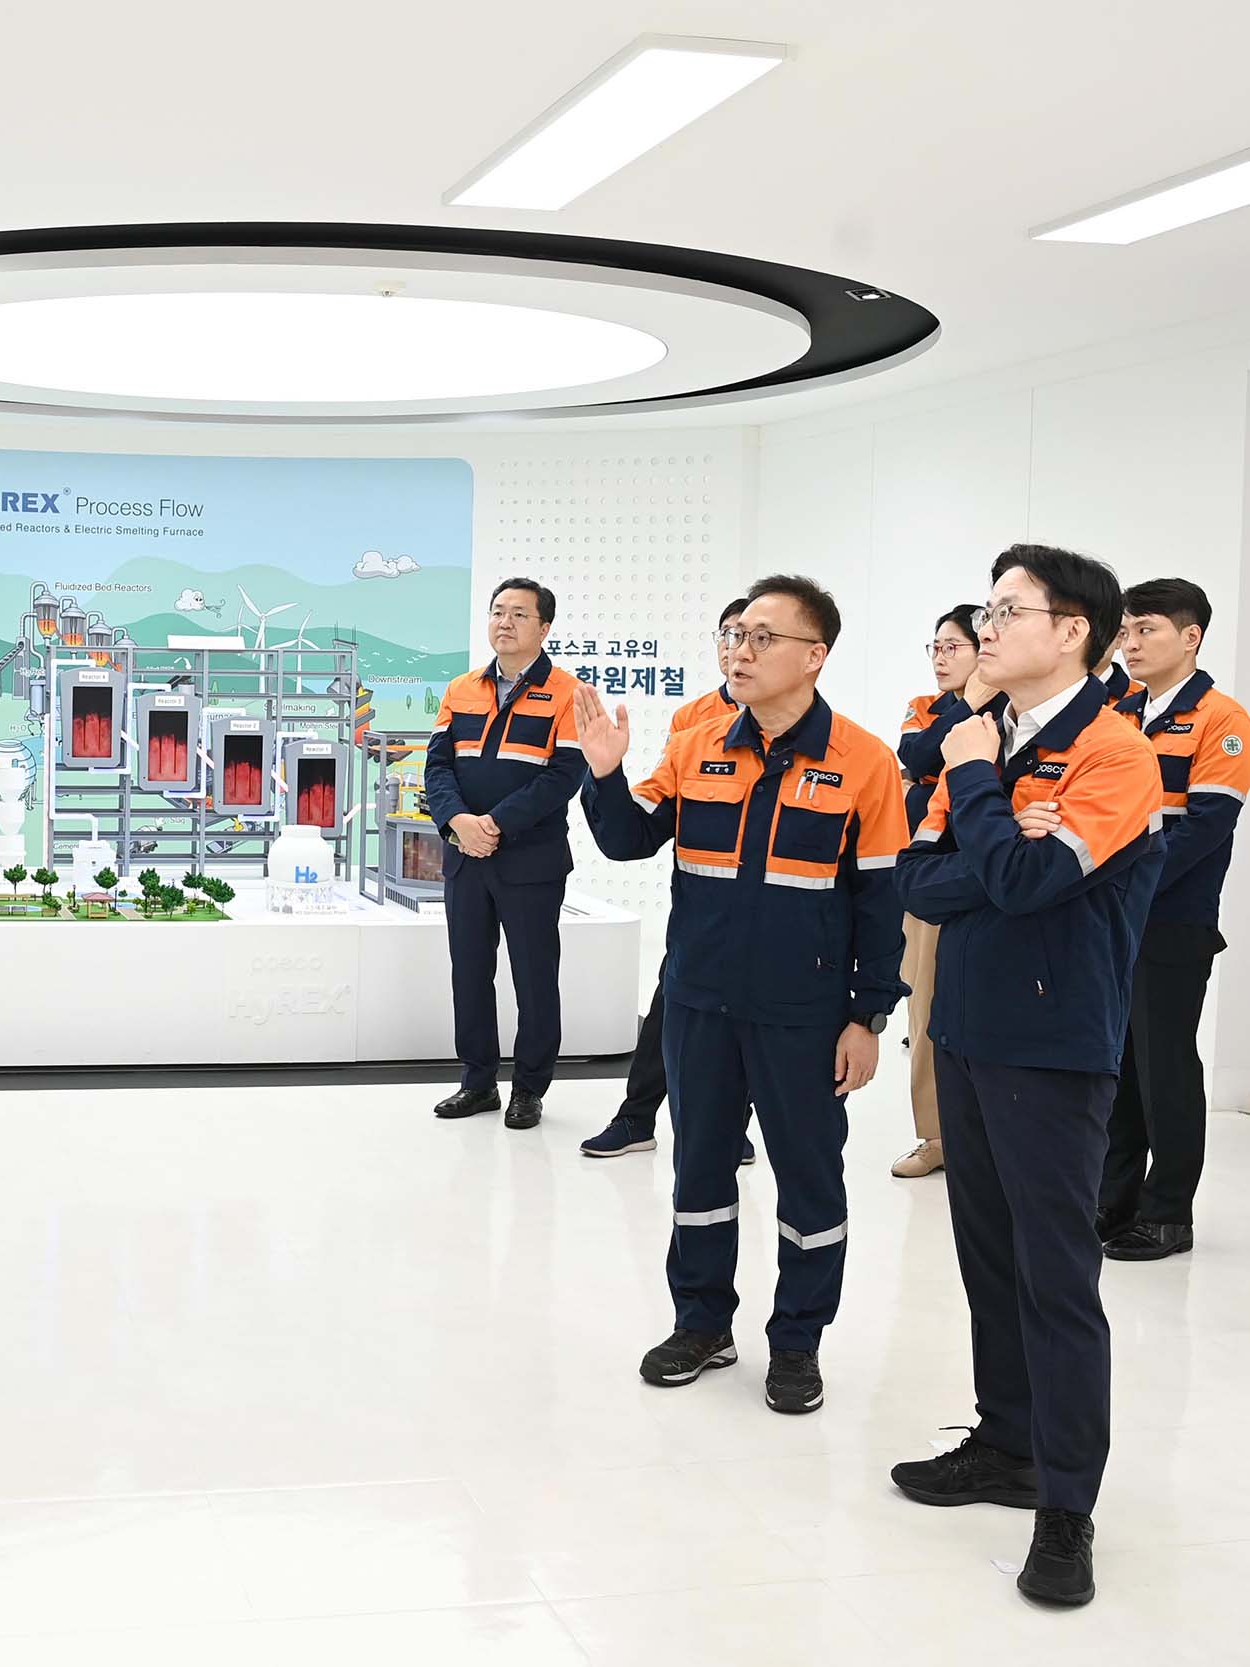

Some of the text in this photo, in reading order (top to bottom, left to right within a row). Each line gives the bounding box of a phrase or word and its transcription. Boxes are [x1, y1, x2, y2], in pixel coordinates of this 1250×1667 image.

[76, 496, 153, 517] Process
[159, 499, 204, 518] Flow
[15, 523, 61, 534] Reactors
[63, 524, 71, 534] &
[74, 524, 112, 535] Electric
[115, 525, 159, 538] Smelting
[162, 527, 204, 537] Furnace
[54, 582, 152, 593] Fluidized Bed Reactors
[547, 639, 658, 658] 포스코 고유의
[368, 674, 422, 684] Downstream
[575, 665, 684, 696] 환원제철
